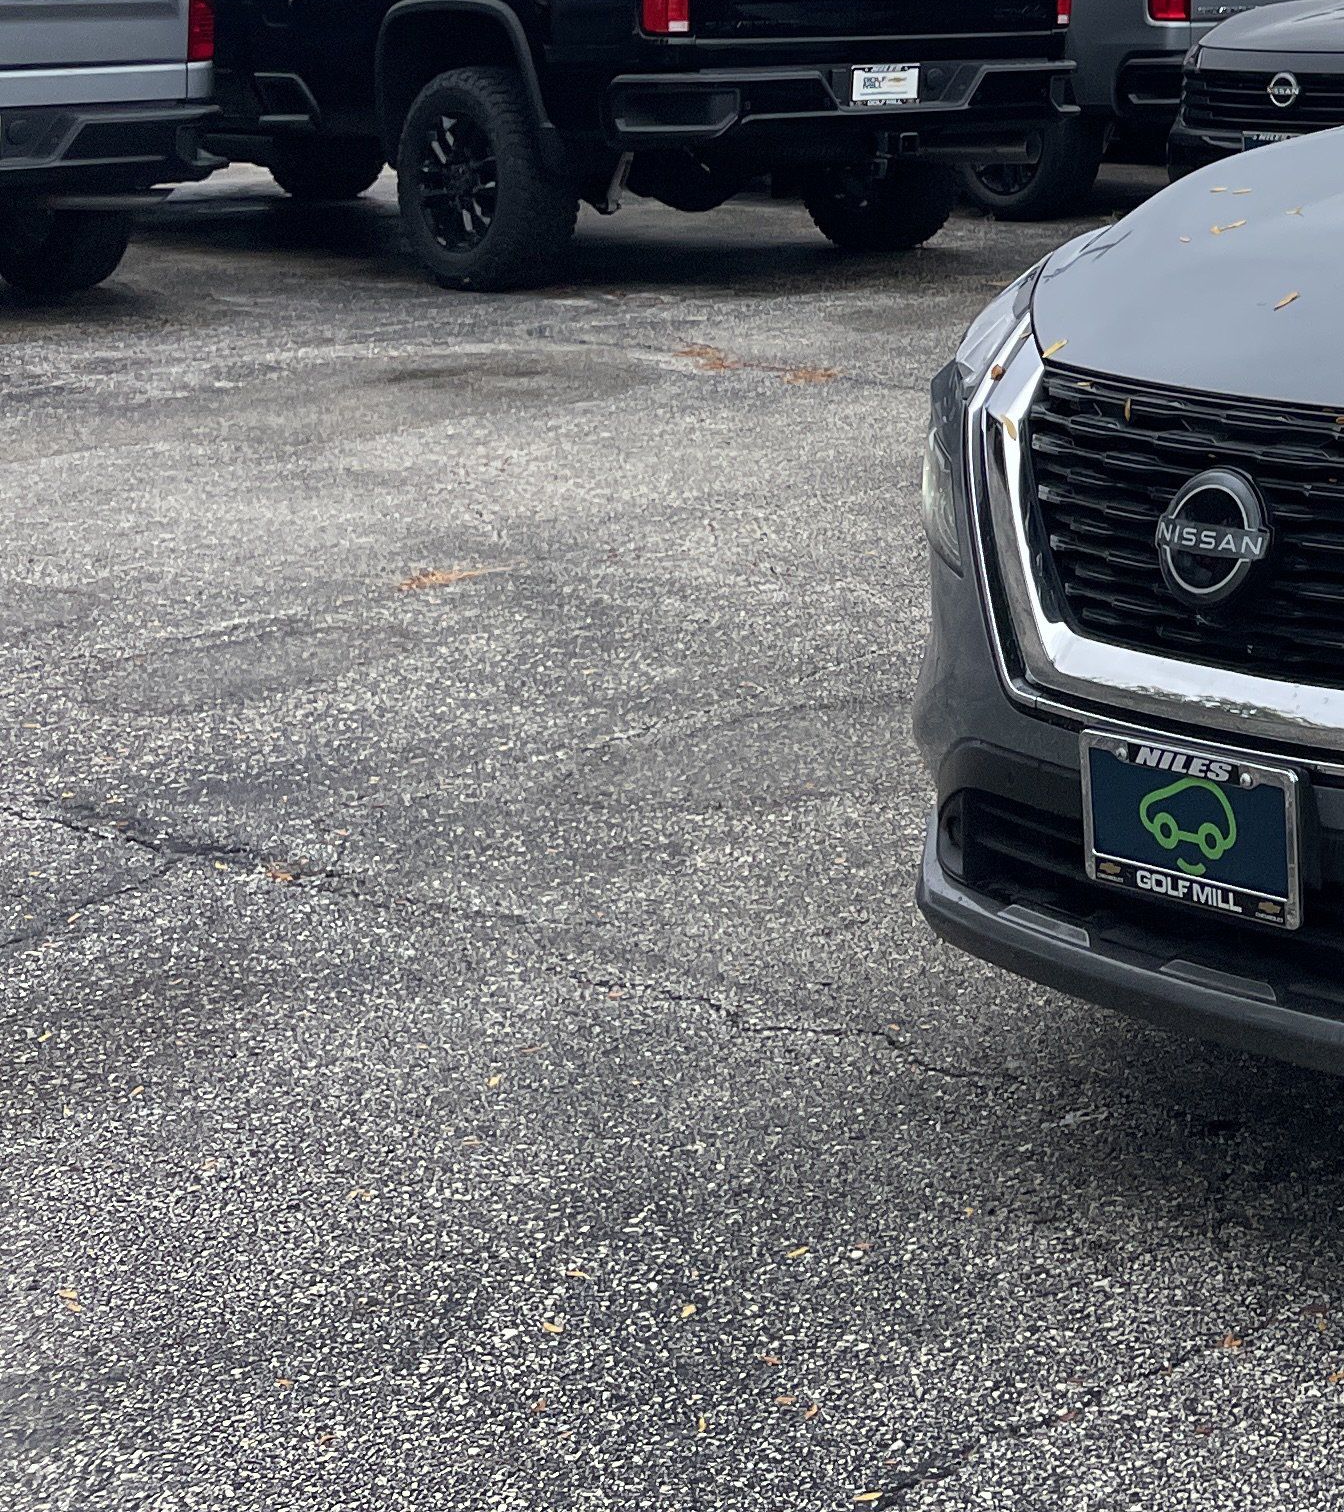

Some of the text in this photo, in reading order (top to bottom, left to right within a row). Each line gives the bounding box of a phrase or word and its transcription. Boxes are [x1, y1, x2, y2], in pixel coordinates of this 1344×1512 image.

[1267, 86, 1300, 95] NISSAN
[1158, 521, 1263, 555] NISSAN
[1135, 746, 1233, 783] NILES
[1135, 869, 1243, 913] GOLF MILL
